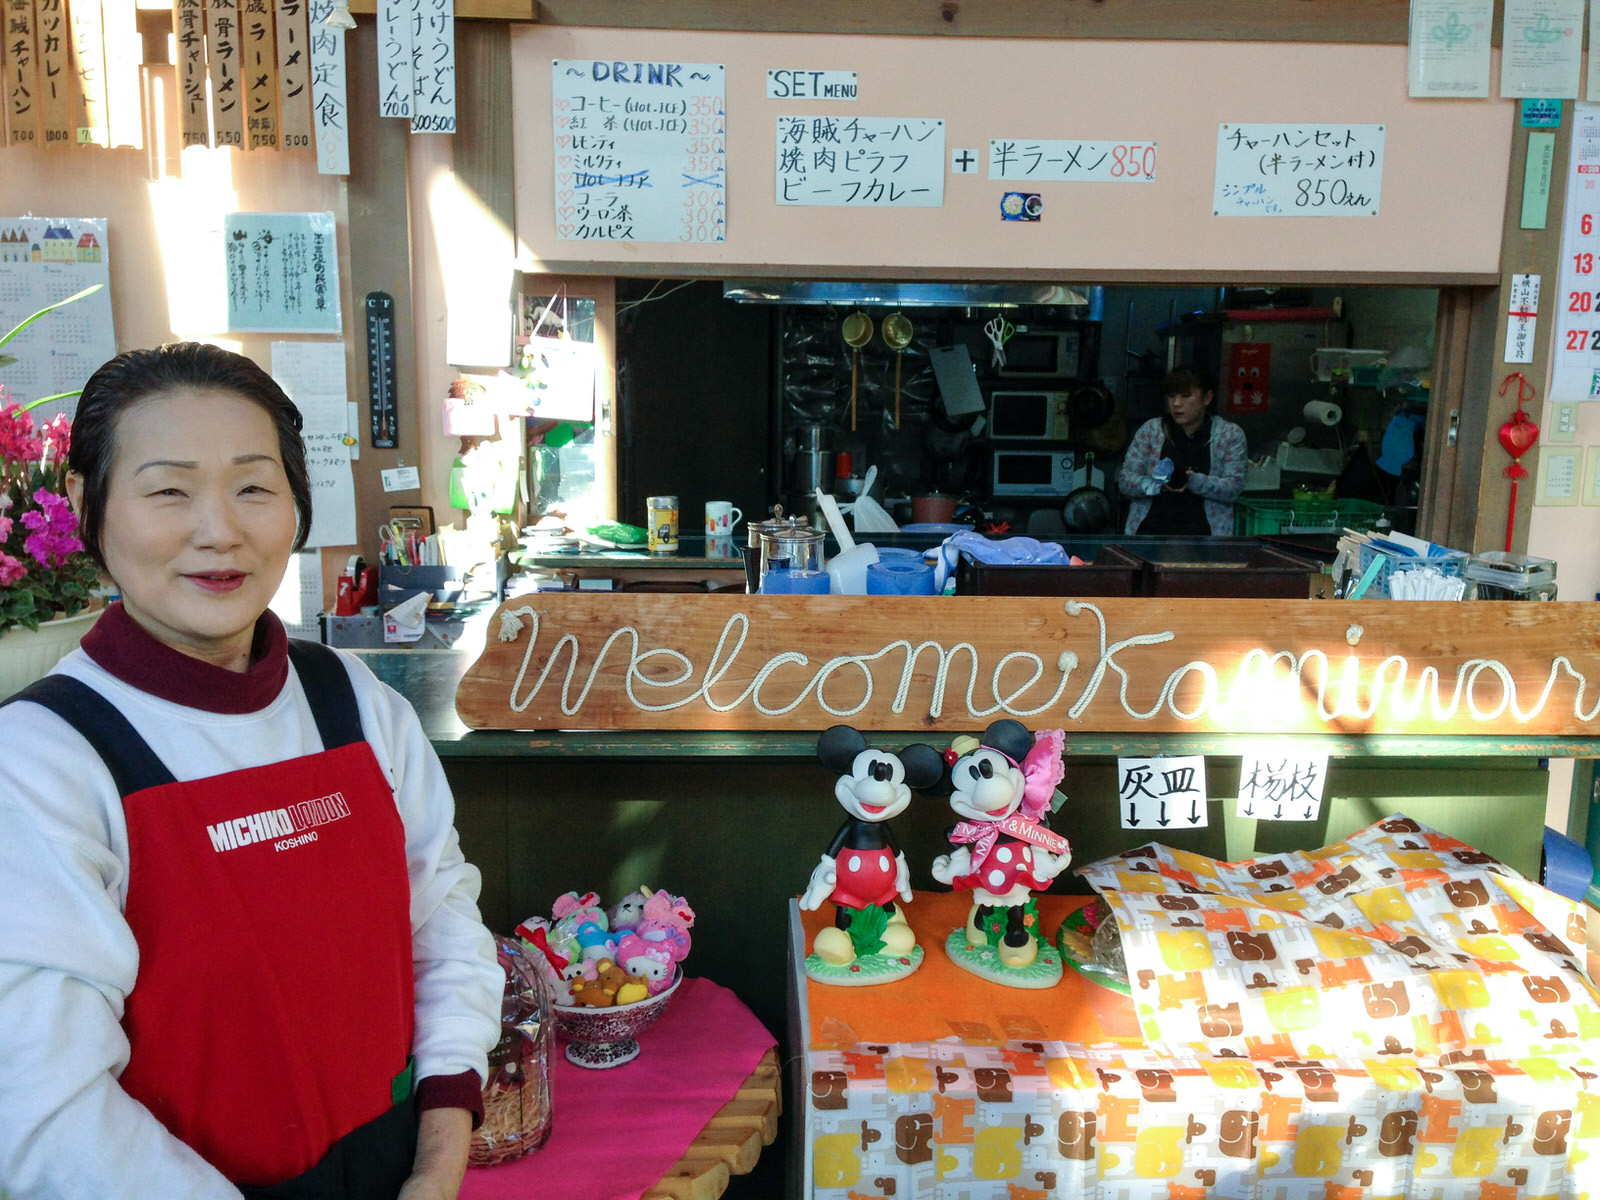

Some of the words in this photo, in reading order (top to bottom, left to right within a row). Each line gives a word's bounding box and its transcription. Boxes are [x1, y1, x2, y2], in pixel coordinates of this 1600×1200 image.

[592, 61, 683, 88] DRINK
[773, 69, 825, 97] SET
[824, 84, 857, 98] MENU
[383, 102, 409, 116] 700
[570, 95, 621, 112] コーヒー
[432, 114, 456, 131] 500
[779, 117, 936, 144] 海賊チャーハン
[45, 130, 69, 142] 1000
[217, 131, 241, 144] 550
[252, 134, 276, 146] 750
[285, 134, 308, 147] 500
[1226, 128, 1357, 151] チャーハンセット
[778, 146, 909, 174] 焼肉ピラフ
[1110, 145, 1157, 178] 850
[1259, 150, 1376, 176] (半ラーメン付)
[577, 192, 619, 208] コーラ
[783, 177, 930, 203] ビーフカレー
[1222, 183, 1267, 197] シンプル
[577, 204, 633, 223] ウーロン茶
[575, 224, 636, 240] カルピス
[1580, 213, 1593, 236] 6
[1573, 253, 1594, 274] 13
[1568, 291, 1592, 312] 20
[1566, 330, 1589, 350] 27
[1591, 330, 1600, 351] 2
[499, 607, 1078, 720] Welcome
[1120, 764, 1200, 800] 灰皿
[206, 808, 294, 853] MICHIKO
[288, 791, 351, 832] LONDON
[274, 831, 318, 852] KOSHINO
